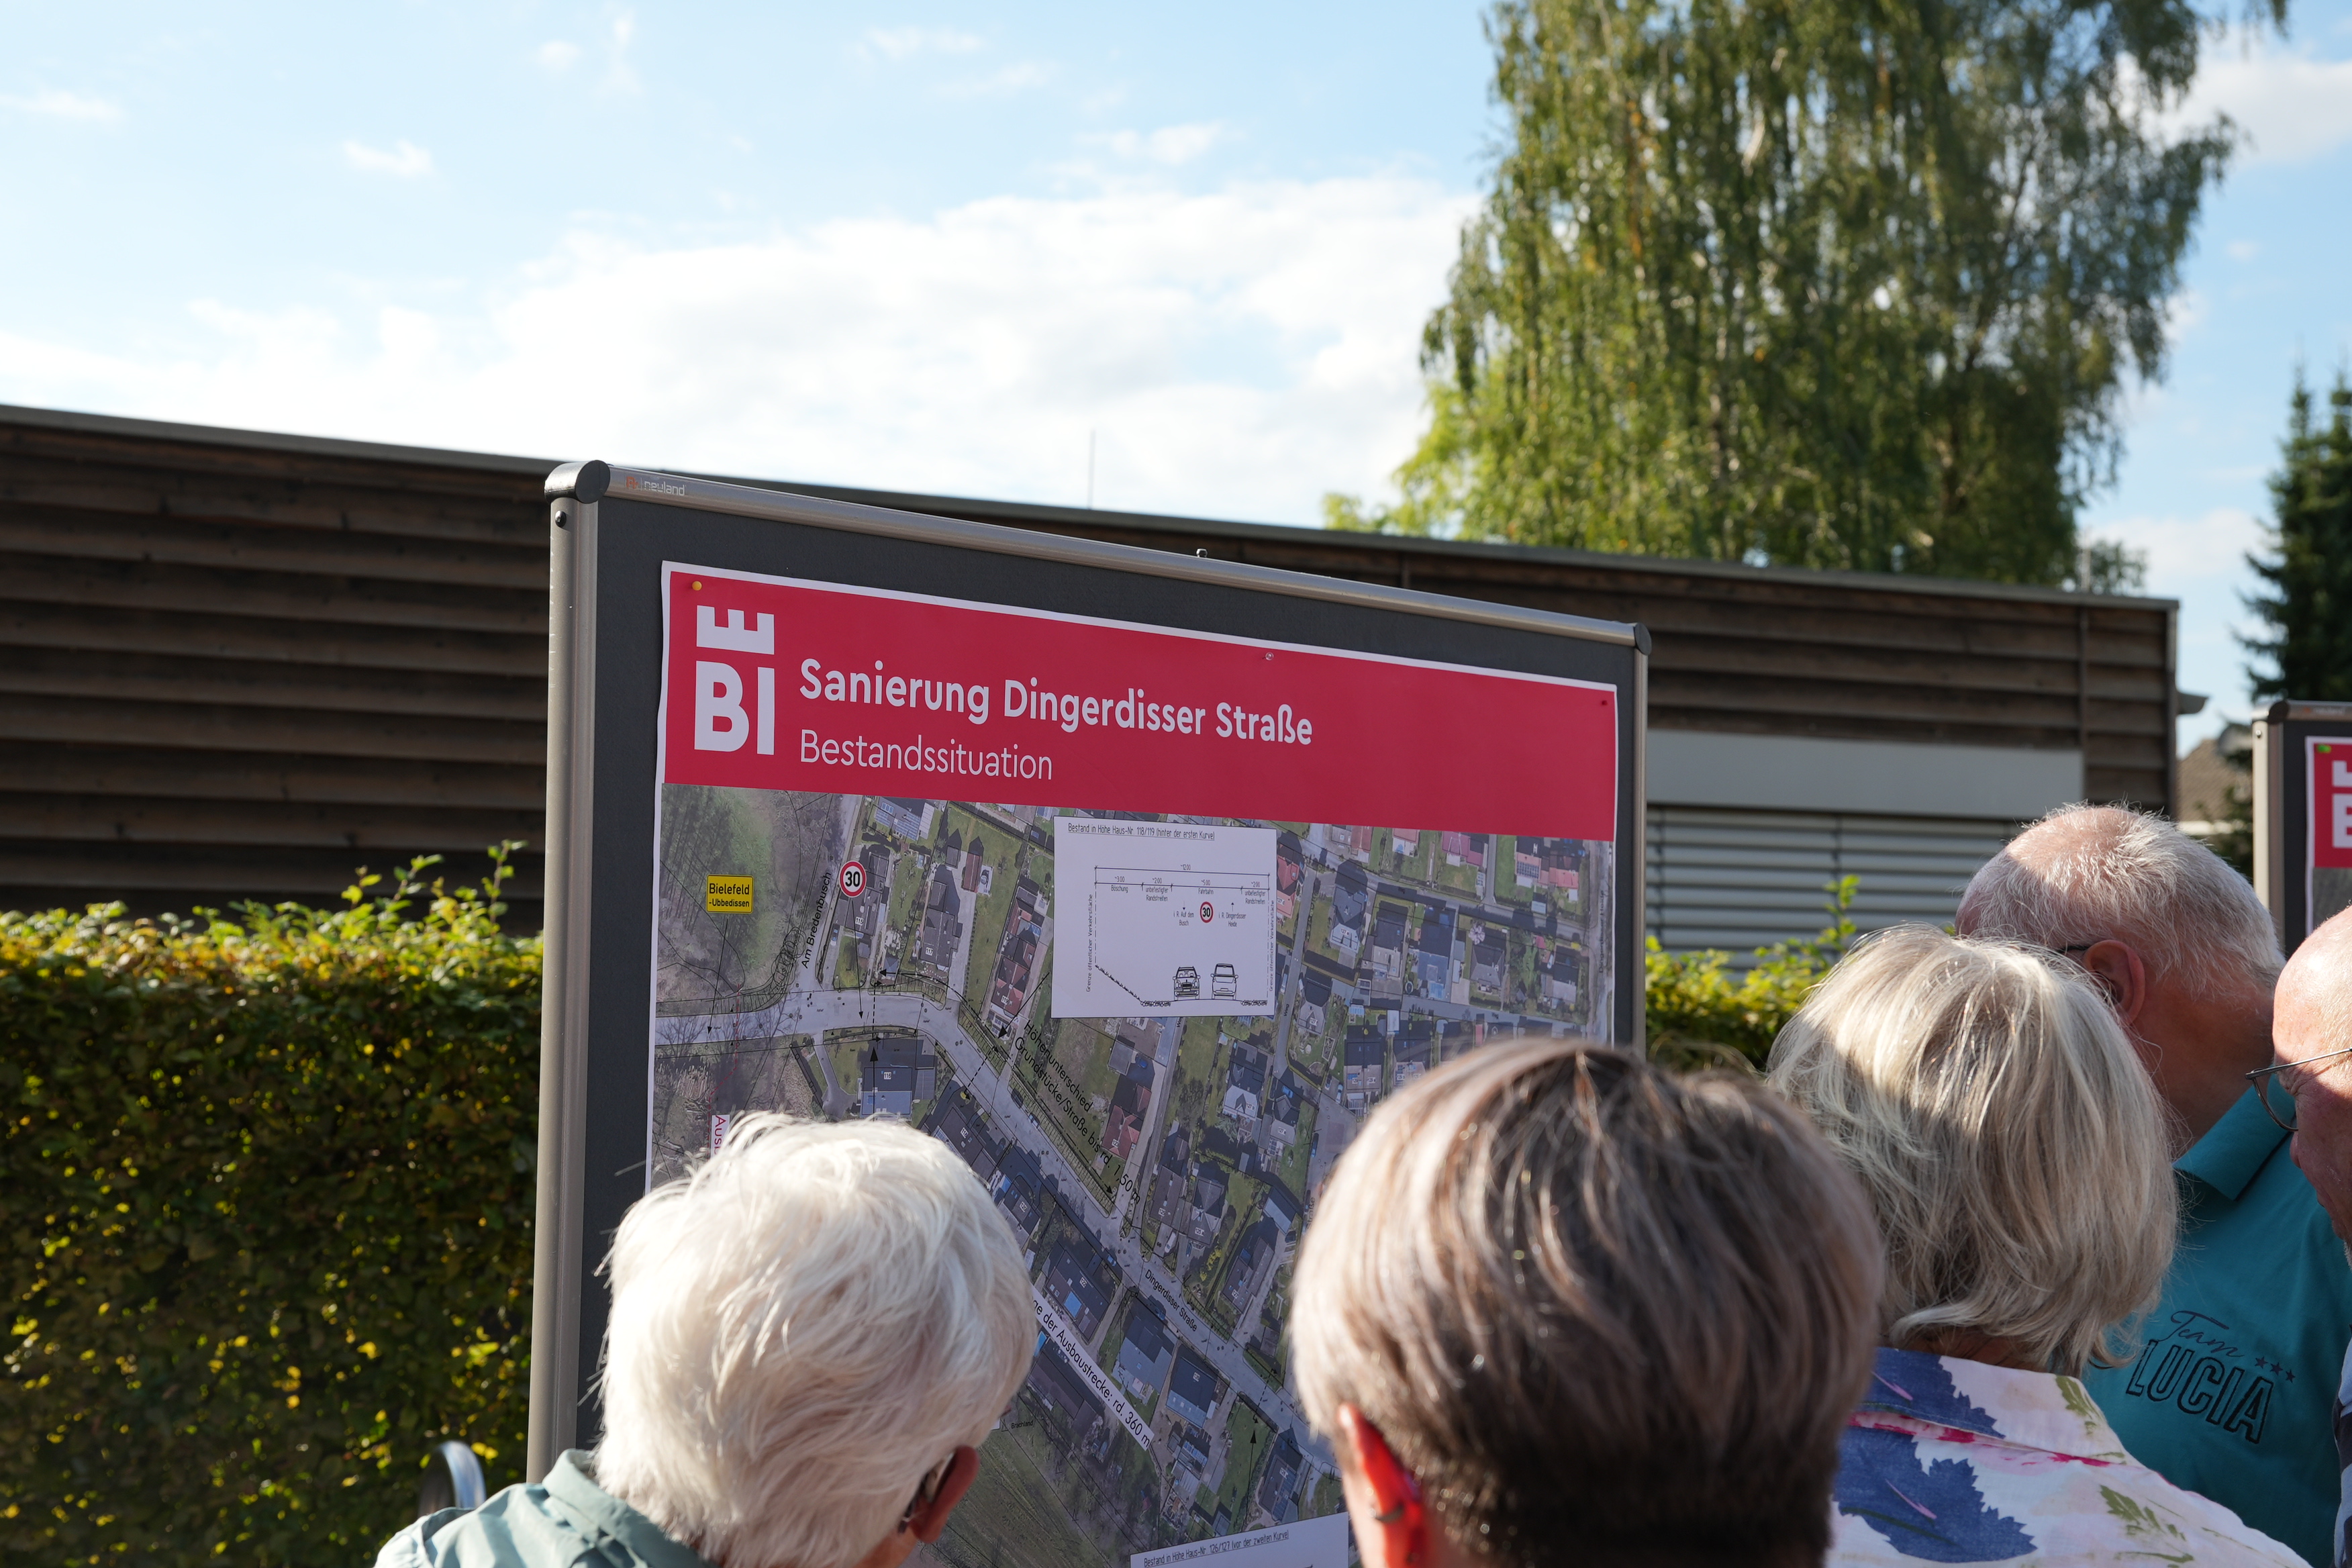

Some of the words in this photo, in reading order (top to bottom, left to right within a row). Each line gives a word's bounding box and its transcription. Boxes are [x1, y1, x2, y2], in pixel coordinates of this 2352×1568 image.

[644, 481, 685, 496] neuland
[799, 658, 989, 725] Sanierung
[1004, 677, 1206, 734] Dingerdisser
[1216, 702, 1312, 745] Straße
[800, 728, 1052, 780] Bestandssituation
[1068, 823, 1089, 833] Bestand
[1091, 824, 1096, 833] in
[1097, 824, 1111, 834] Höhe
[1112, 826, 1134, 835] Haus-Nr.
[1136, 827, 1155, 836] 118/119
[1157, 827, 1172, 837] (hinter
[1183, 830, 1198, 838] ersten
[1199, 830, 1215, 840] Kurve)
[709, 883, 750, 895] Bielefeld
[844, 871, 861, 888] 30
[1111, 885, 1128, 893] Böschung
[1145, 887, 1169, 895] unbefestigter
[709, 898, 750, 908] -Ubbedissen
[806, 872, 832, 946] Bredenbusch
[1202, 908, 1211, 918] 30
[801, 948, 812, 969] Am
[1024, 1020, 1093, 1113] Höhenunterschied
[1015, 1036, 1088, 1136] Grundstücke/Straße
[1087, 1132, 1101, 1153] bis
[1100, 1150, 1112, 1169] rd.
[1114, 1165, 1133, 1191] 1,50
[1132, 1193, 1140, 1204] m
[1145, 1269, 1179, 1311] Dingerdisser
[1179, 1307, 1197, 1332] Straße
[2157, 1310, 2245, 1357] Team
[1043, 1312, 1058, 1332] der
[1056, 1329, 1113, 1402] Ausbaustrecke:
[1112, 1400, 1126, 1416] rd.
[1125, 1411, 1143, 1436] 360
[1141, 1434, 1150, 1447] m
[2126, 1339, 2274, 1444] LUCIA
[1144, 1554, 1165, 1567] Bestand
[1166, 1553, 1171, 1563] in
[1209, 1541, 1230, 1553] 126/127
[1231, 1540, 1242, 1551] (vor
[1243, 1536, 1251, 1547] der
[1253, 1533, 1272, 1545] zweiten
[1273, 1530, 1289, 1542] Kurve)
